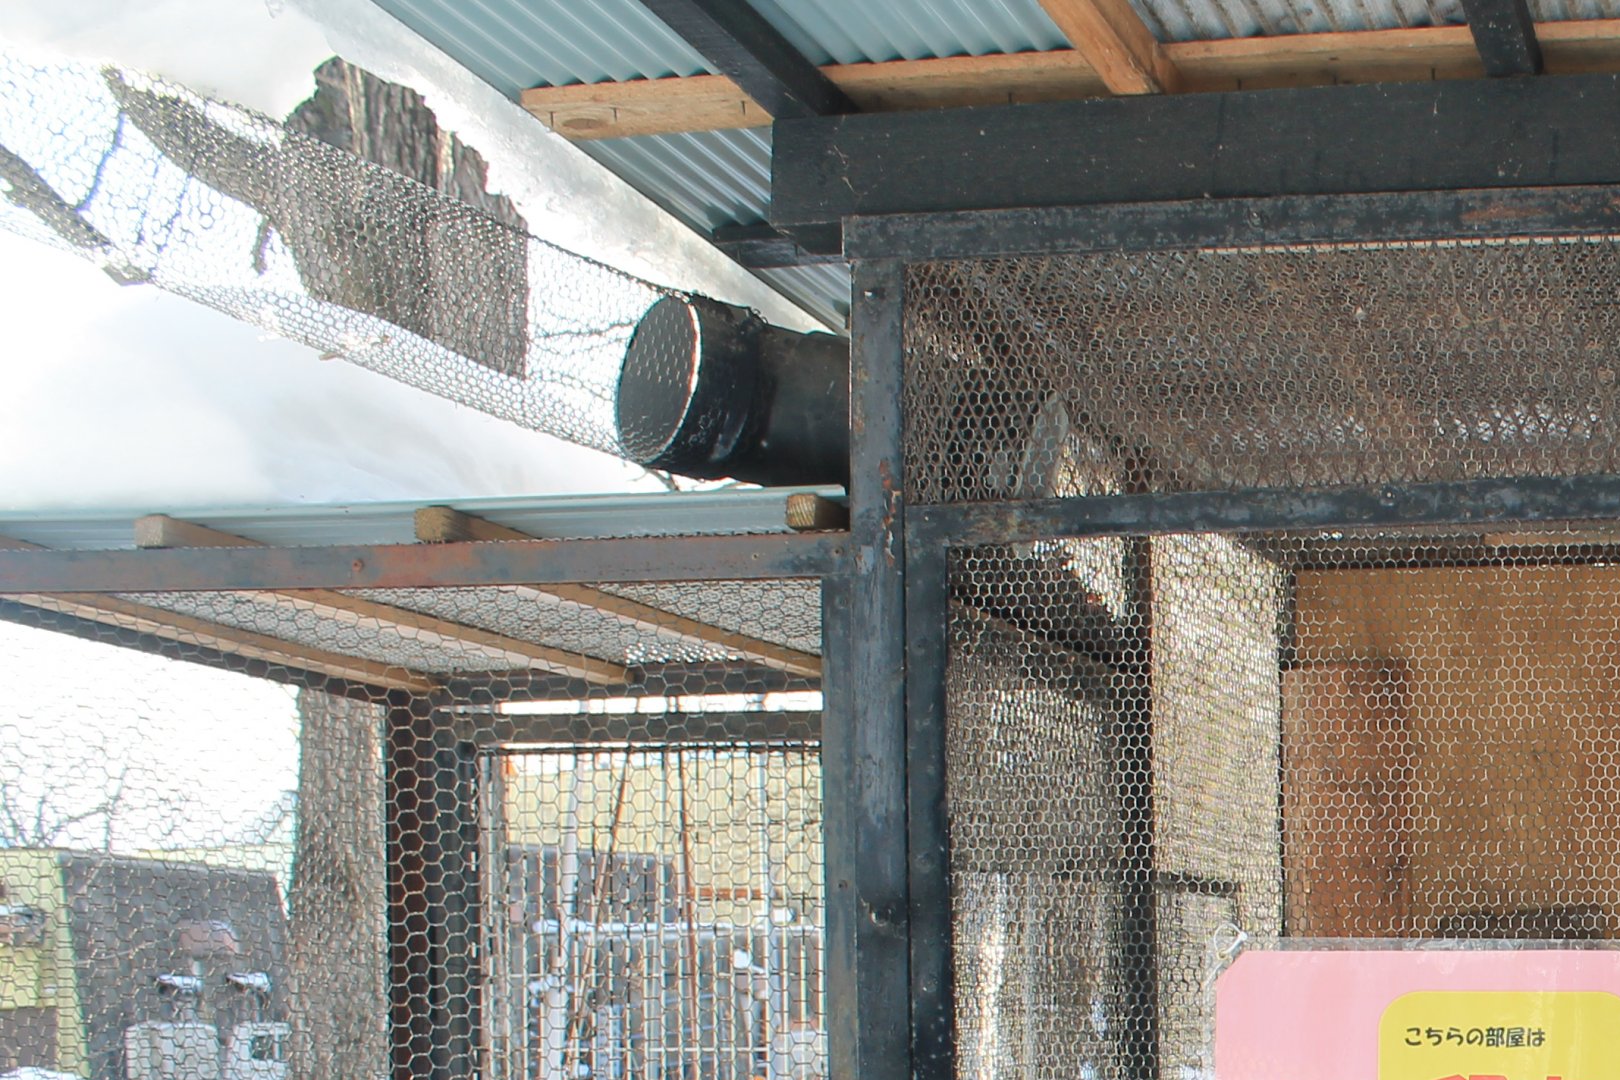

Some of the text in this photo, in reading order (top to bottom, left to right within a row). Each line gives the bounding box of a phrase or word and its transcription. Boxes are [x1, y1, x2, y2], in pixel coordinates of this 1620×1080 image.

[1404, 1026, 1546, 1048] こちらの部屋は
